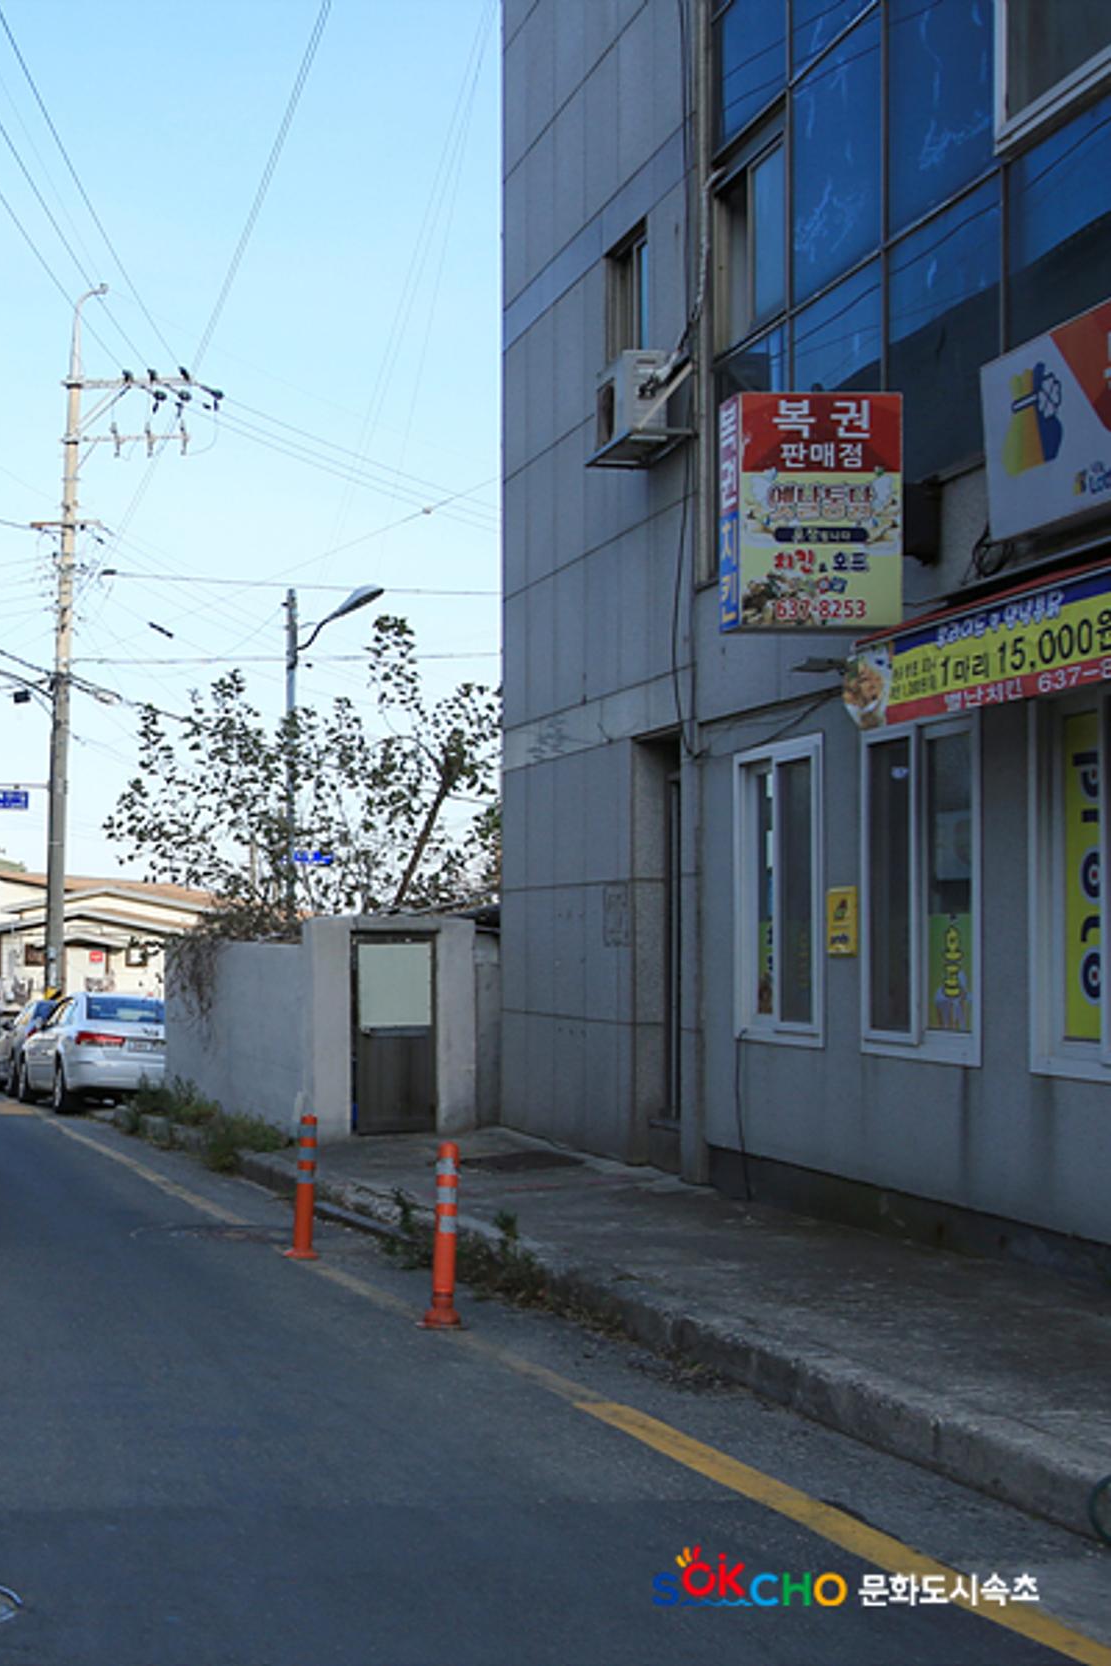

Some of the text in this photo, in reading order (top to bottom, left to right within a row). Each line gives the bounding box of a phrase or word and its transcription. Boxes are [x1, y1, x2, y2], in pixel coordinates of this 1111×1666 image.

[772, 400, 871, 439] 복권
[780, 443, 863, 468] 판매점
[721, 518, 738, 628] 치킨
[774, 549, 815, 574] 치킨
[775, 600, 867, 619] 637-8253
[941, 651, 989, 687] 1마리
[998, 610, 1111, 673] 15,000원
